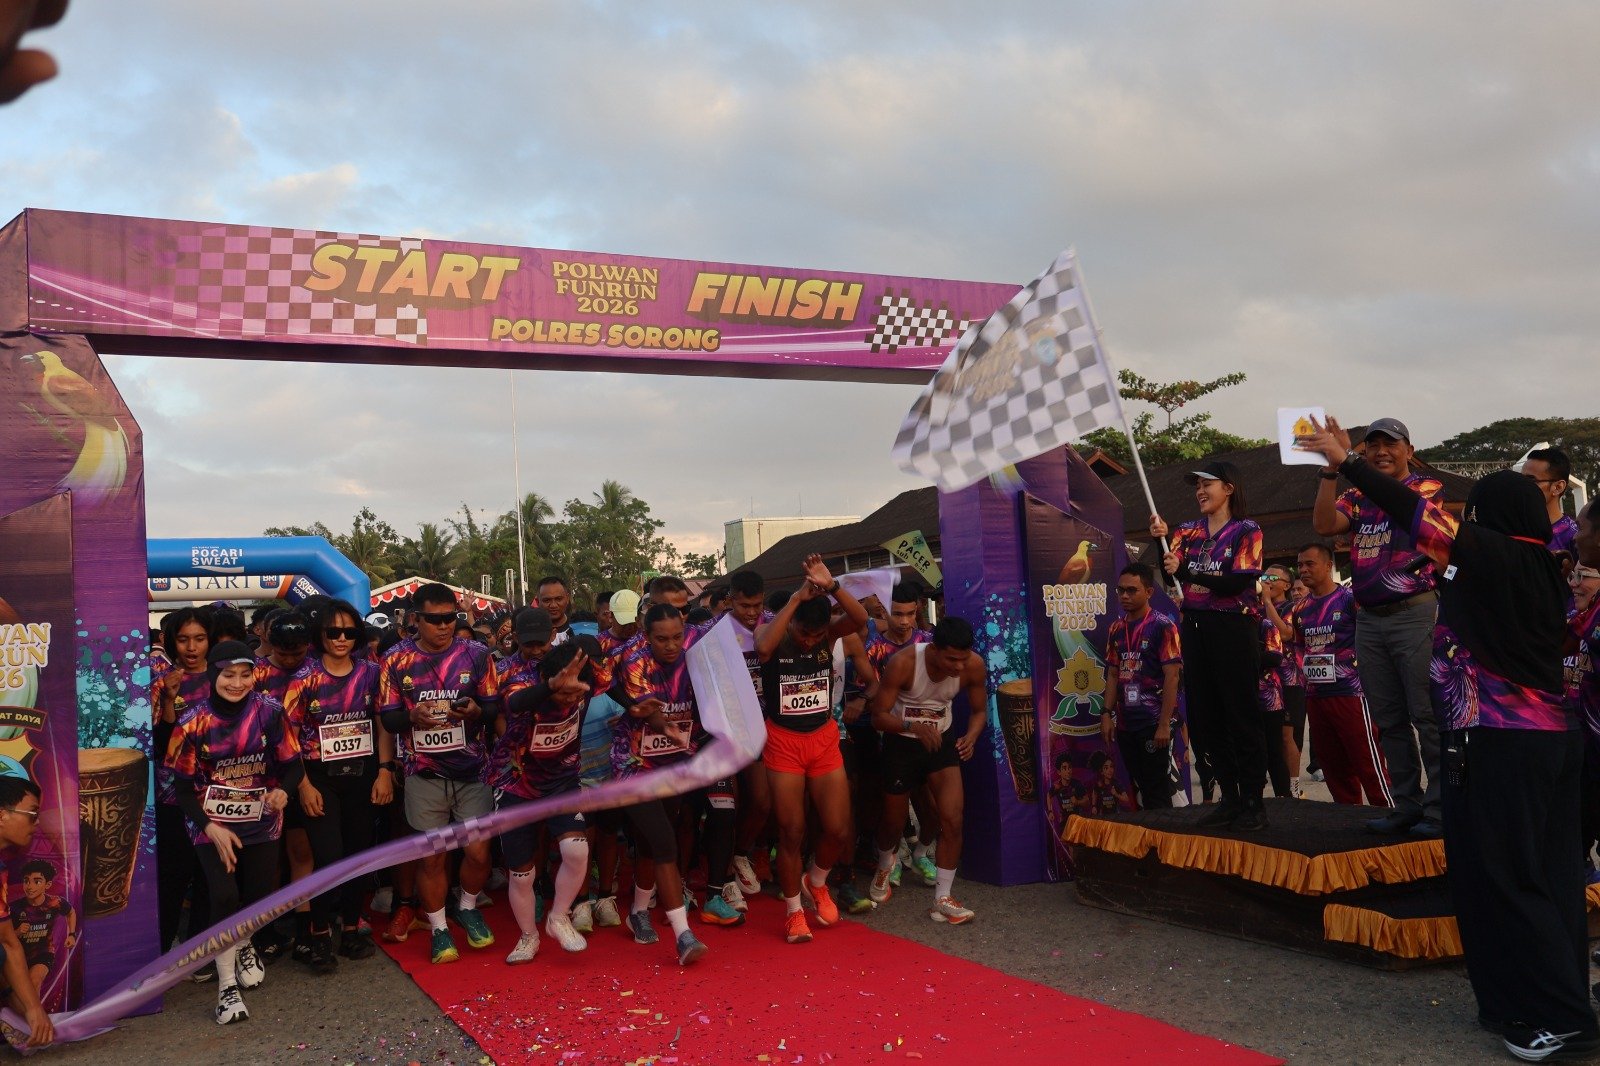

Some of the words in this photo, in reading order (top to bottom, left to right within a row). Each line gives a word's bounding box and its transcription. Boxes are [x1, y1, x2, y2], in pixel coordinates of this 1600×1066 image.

[304, 244, 520, 301] START
[552, 261, 658, 284] POLWAN
[556, 277, 656, 301] FUNRUN
[687, 272, 863, 322] FINISH
[577, 296, 639, 316] 2026
[491, 318, 601, 345] POLRES
[608, 325, 720, 352] SORONG
[191, 548, 243, 557] POCARI
[898, 540, 930, 569] PACER
[191, 557, 239, 566] SWEAT
[1043, 583, 1107, 601] POLWAN
[1046, 599, 1106, 617] FUNRUN
[1059, 614, 1097, 630] 2026
[1304, 625, 1333, 637] POLWAN
[1307, 667, 1328, 678] 0006
[418, 688, 460, 702] POLWAN
[791, 694, 820, 710] 0264
[15, 713, 41, 725] DAYA
[324, 709, 367, 725] POLWAN
[333, 738, 362, 753] 0337
[424, 731, 454, 746] 0061
[215, 752, 265, 771] POLWAN
[216, 803, 252, 816] 0643
